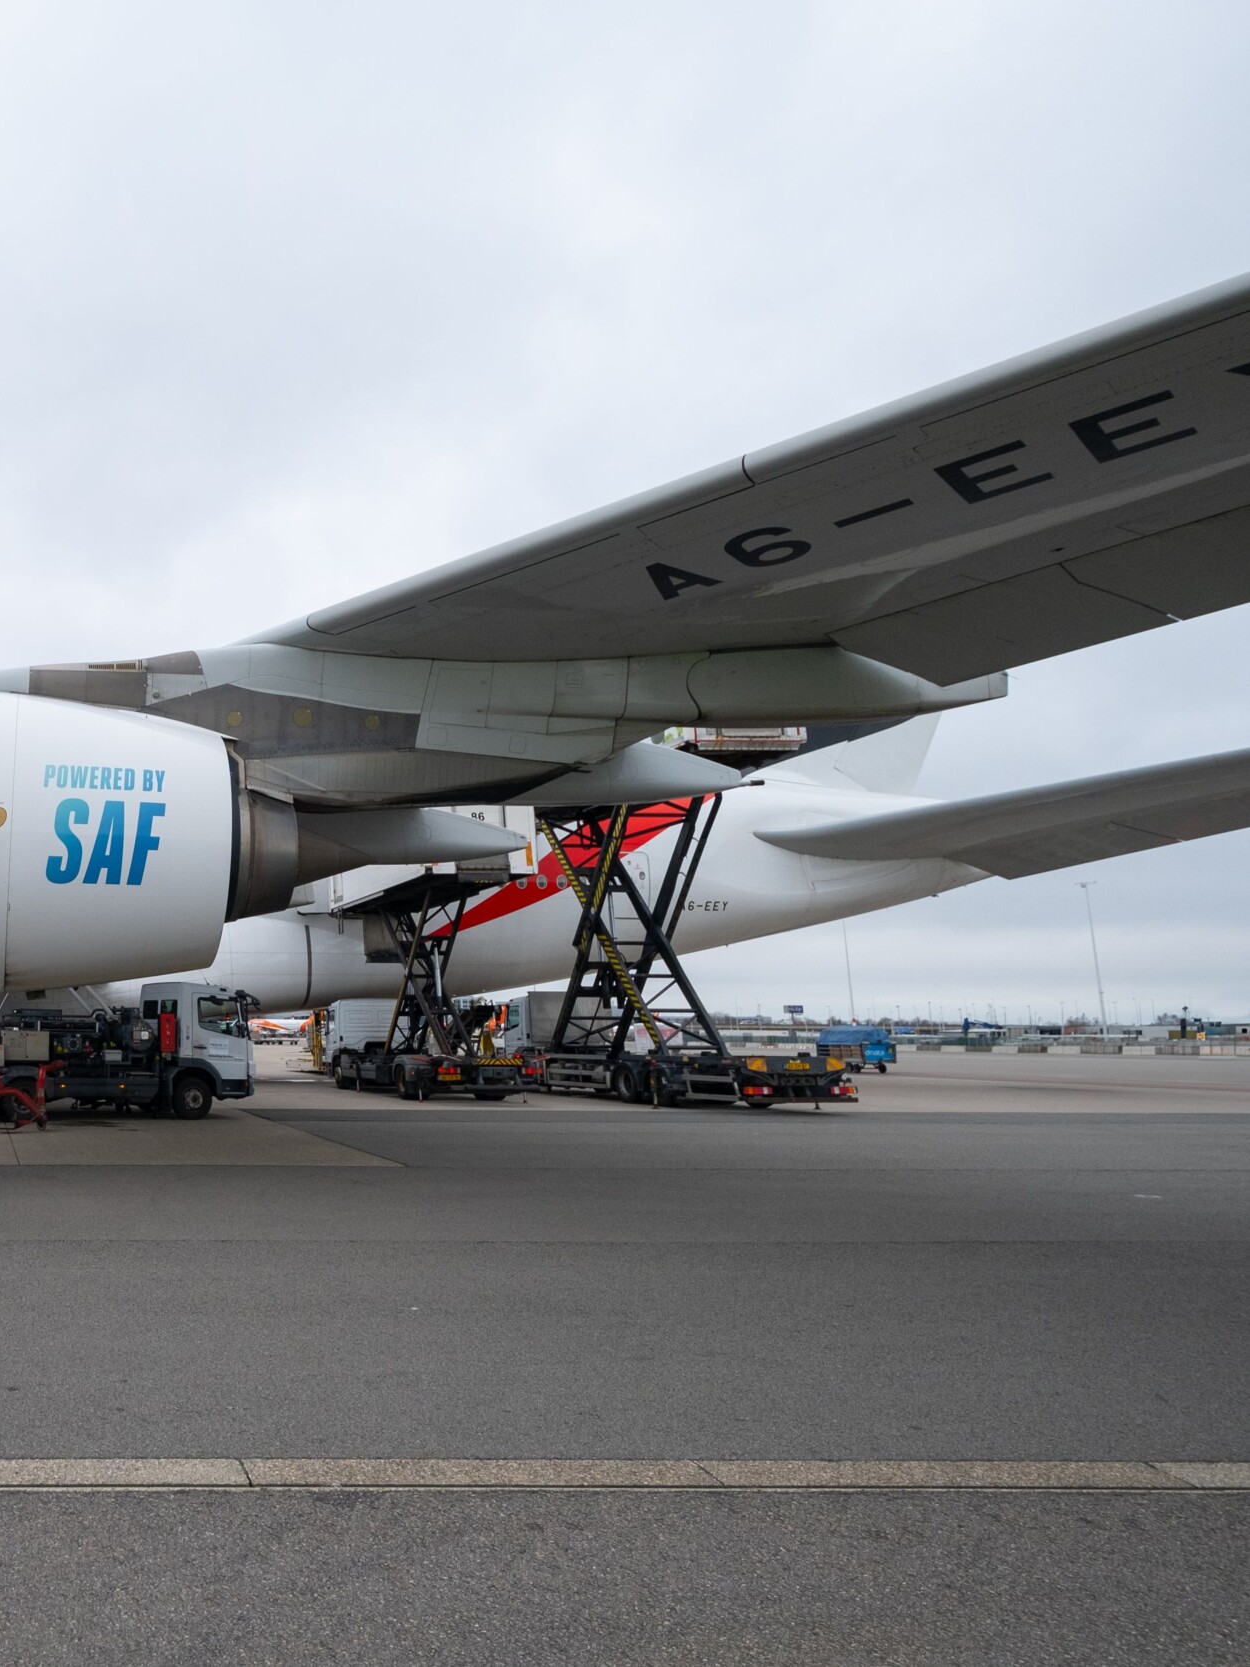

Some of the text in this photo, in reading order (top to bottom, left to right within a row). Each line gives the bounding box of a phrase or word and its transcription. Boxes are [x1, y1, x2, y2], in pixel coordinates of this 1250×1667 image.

[646, 361, 1250, 600] A6-EE
[44, 764, 166, 793] POWERED BY
[471, 812, 485, 821] 86
[45, 797, 166, 886] SAF
[681, 900, 729, 911] 6-EEY
[864, 1047, 885, 1056] dnata
